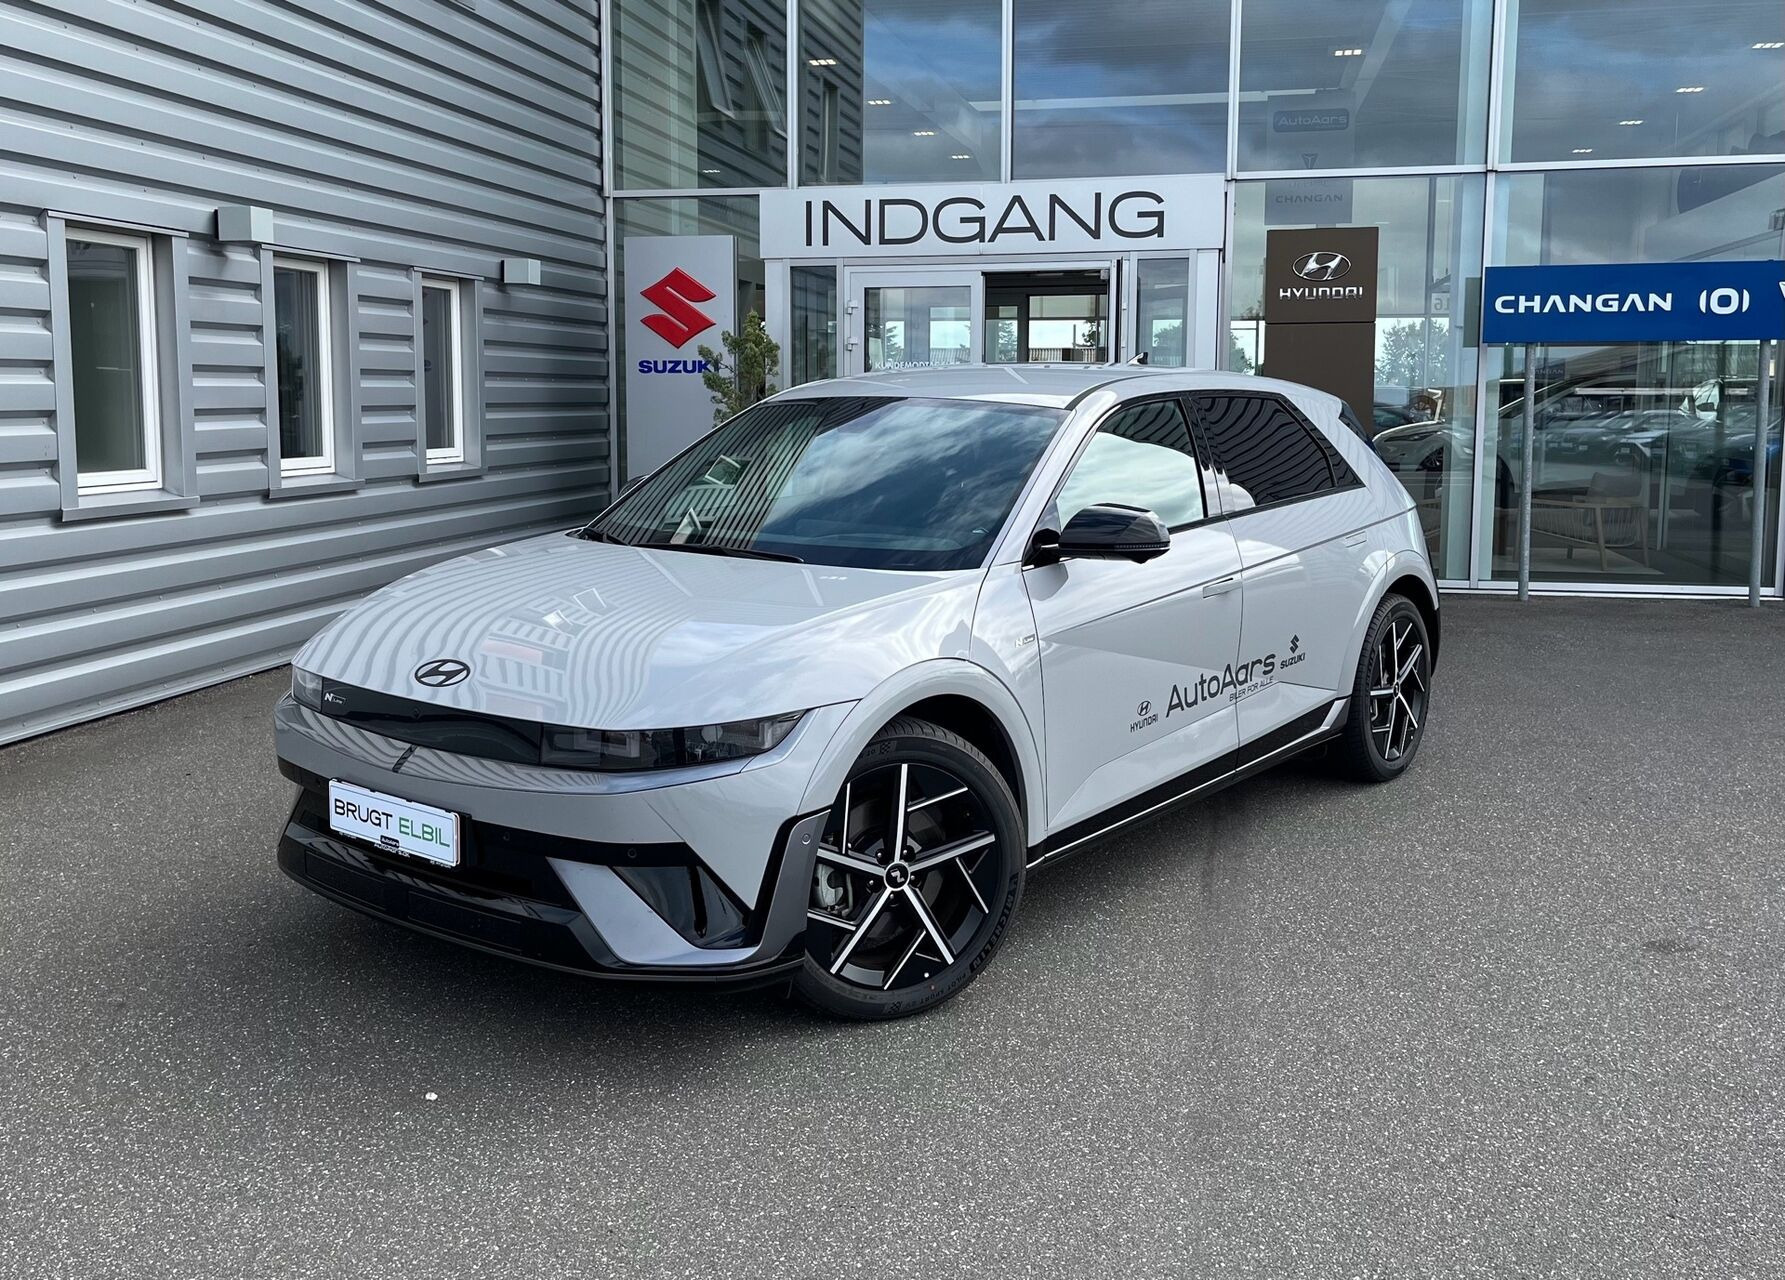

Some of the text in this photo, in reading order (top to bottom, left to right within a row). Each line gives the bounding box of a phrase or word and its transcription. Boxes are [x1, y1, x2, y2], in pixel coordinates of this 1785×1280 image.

[805, 191, 1165, 246] INDGANG
[1279, 287, 1363, 300] HYUNDAI
[1494, 293, 1672, 314] CHANGAN
[1280, 652, 1306, 670] SUZUKI
[1166, 653, 1276, 718] AutoAars
[1130, 713, 1159, 733] HYUNDAI
[334, 798, 451, 848] BRUGT ELBIL
